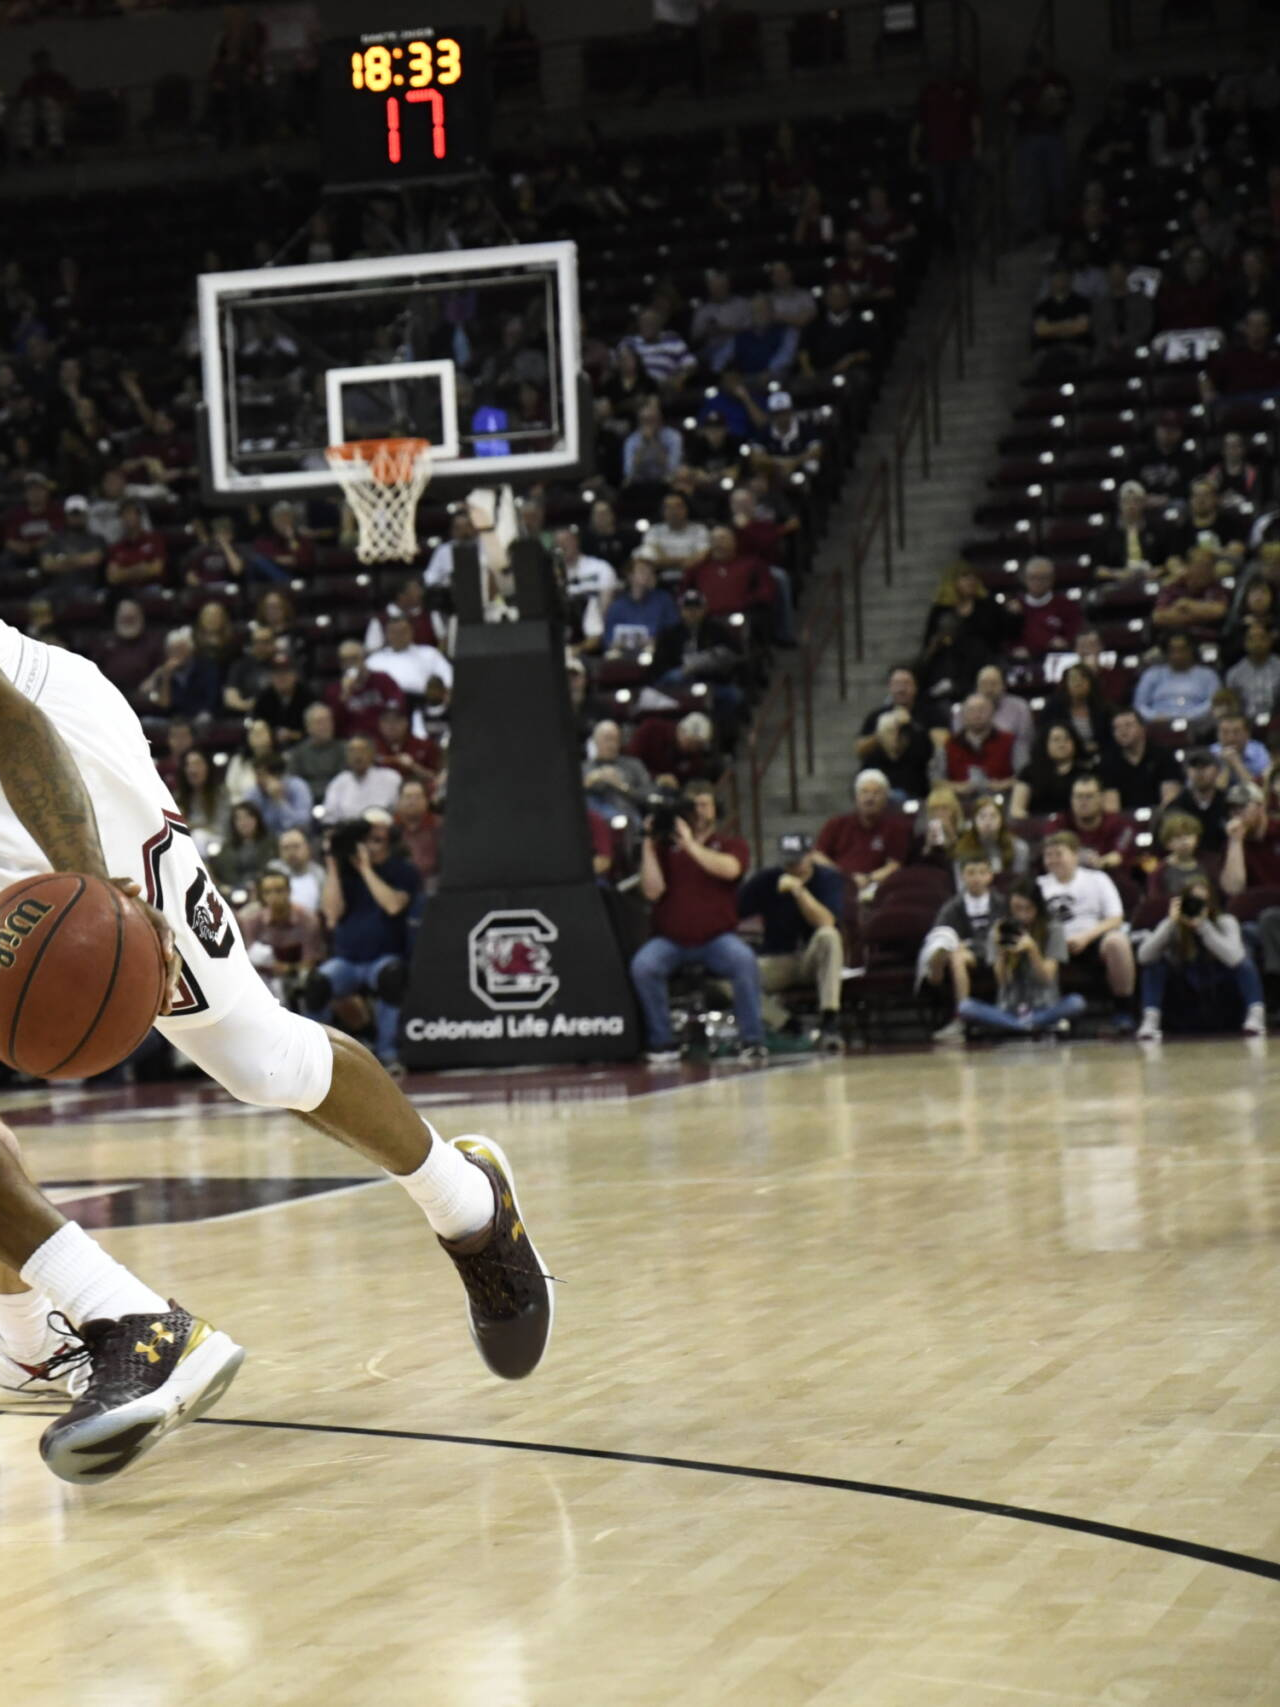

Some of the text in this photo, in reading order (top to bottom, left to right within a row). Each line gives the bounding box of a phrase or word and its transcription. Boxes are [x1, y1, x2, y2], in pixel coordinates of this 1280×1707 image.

[351, 38, 462, 92] 18:33
[386, 88, 446, 164] 17
[405, 1013, 624, 1041] Colonial Life Arena
